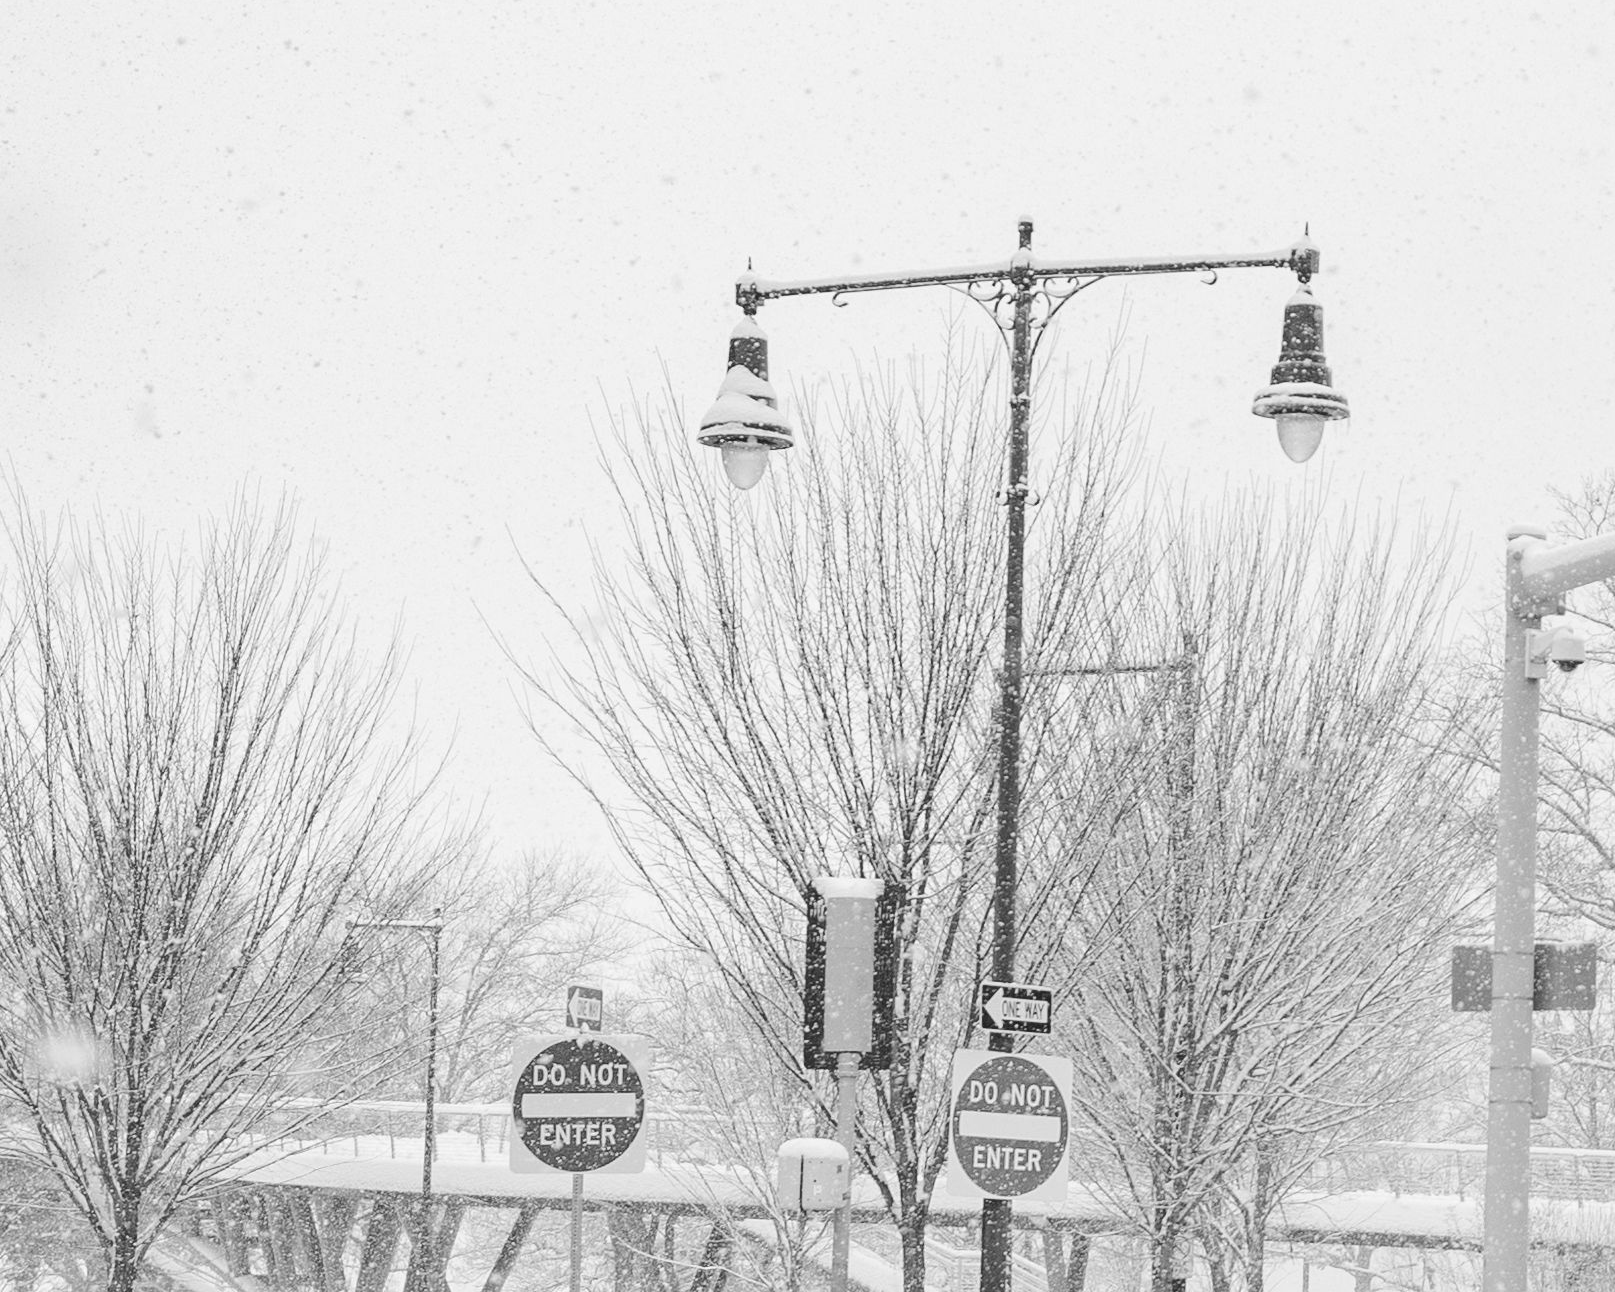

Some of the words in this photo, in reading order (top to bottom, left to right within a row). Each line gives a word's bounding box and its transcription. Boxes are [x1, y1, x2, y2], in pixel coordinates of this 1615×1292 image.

[1001, 999, 1021, 1018] ONE
[1024, 1001, 1046, 1020] WAY
[532, 1063, 566, 1086] DO
[579, 1063, 628, 1086] NOT
[969, 1079, 998, 1105] DO
[1010, 1082, 1055, 1108] NOT
[539, 1123, 617, 1146] ENTER
[972, 1145, 1042, 1172] ENTER
